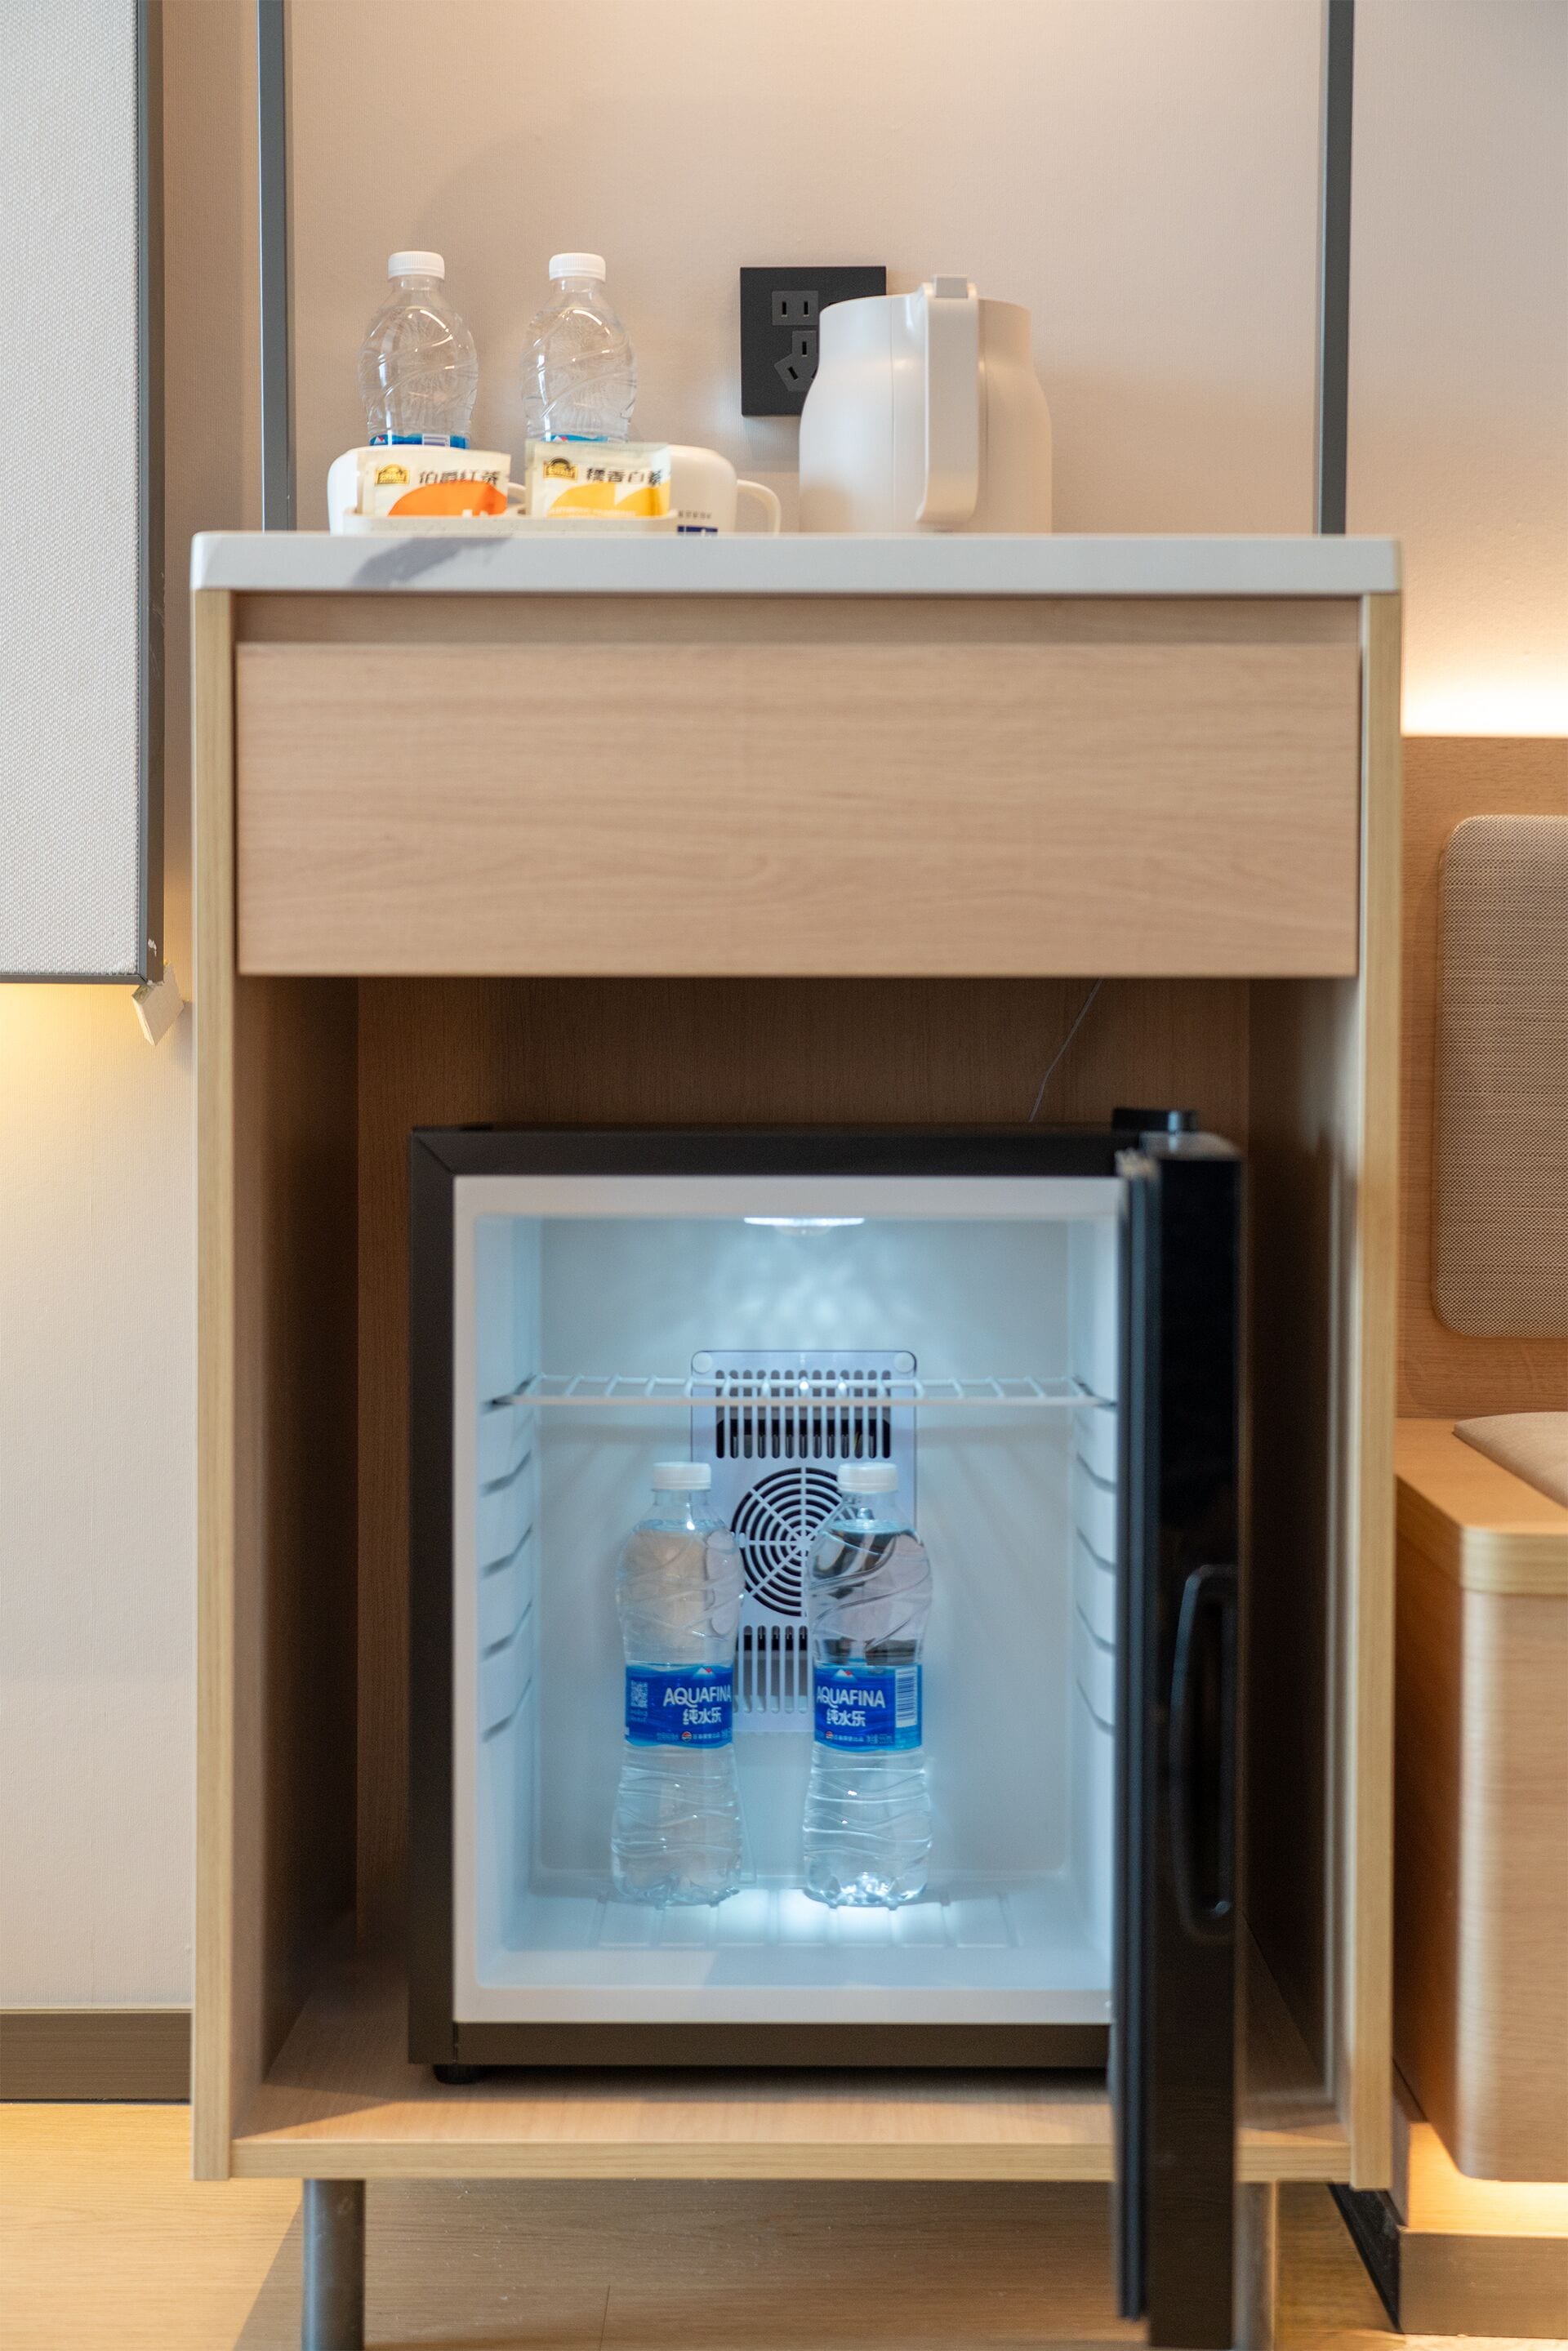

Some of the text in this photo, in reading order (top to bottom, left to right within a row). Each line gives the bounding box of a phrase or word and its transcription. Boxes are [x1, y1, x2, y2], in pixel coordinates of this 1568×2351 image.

[817, 1685, 885, 1708] AQUAFINA
[683, 1706, 722, 1725] 纯水乐
[826, 1708, 866, 1726] 纯水乐
